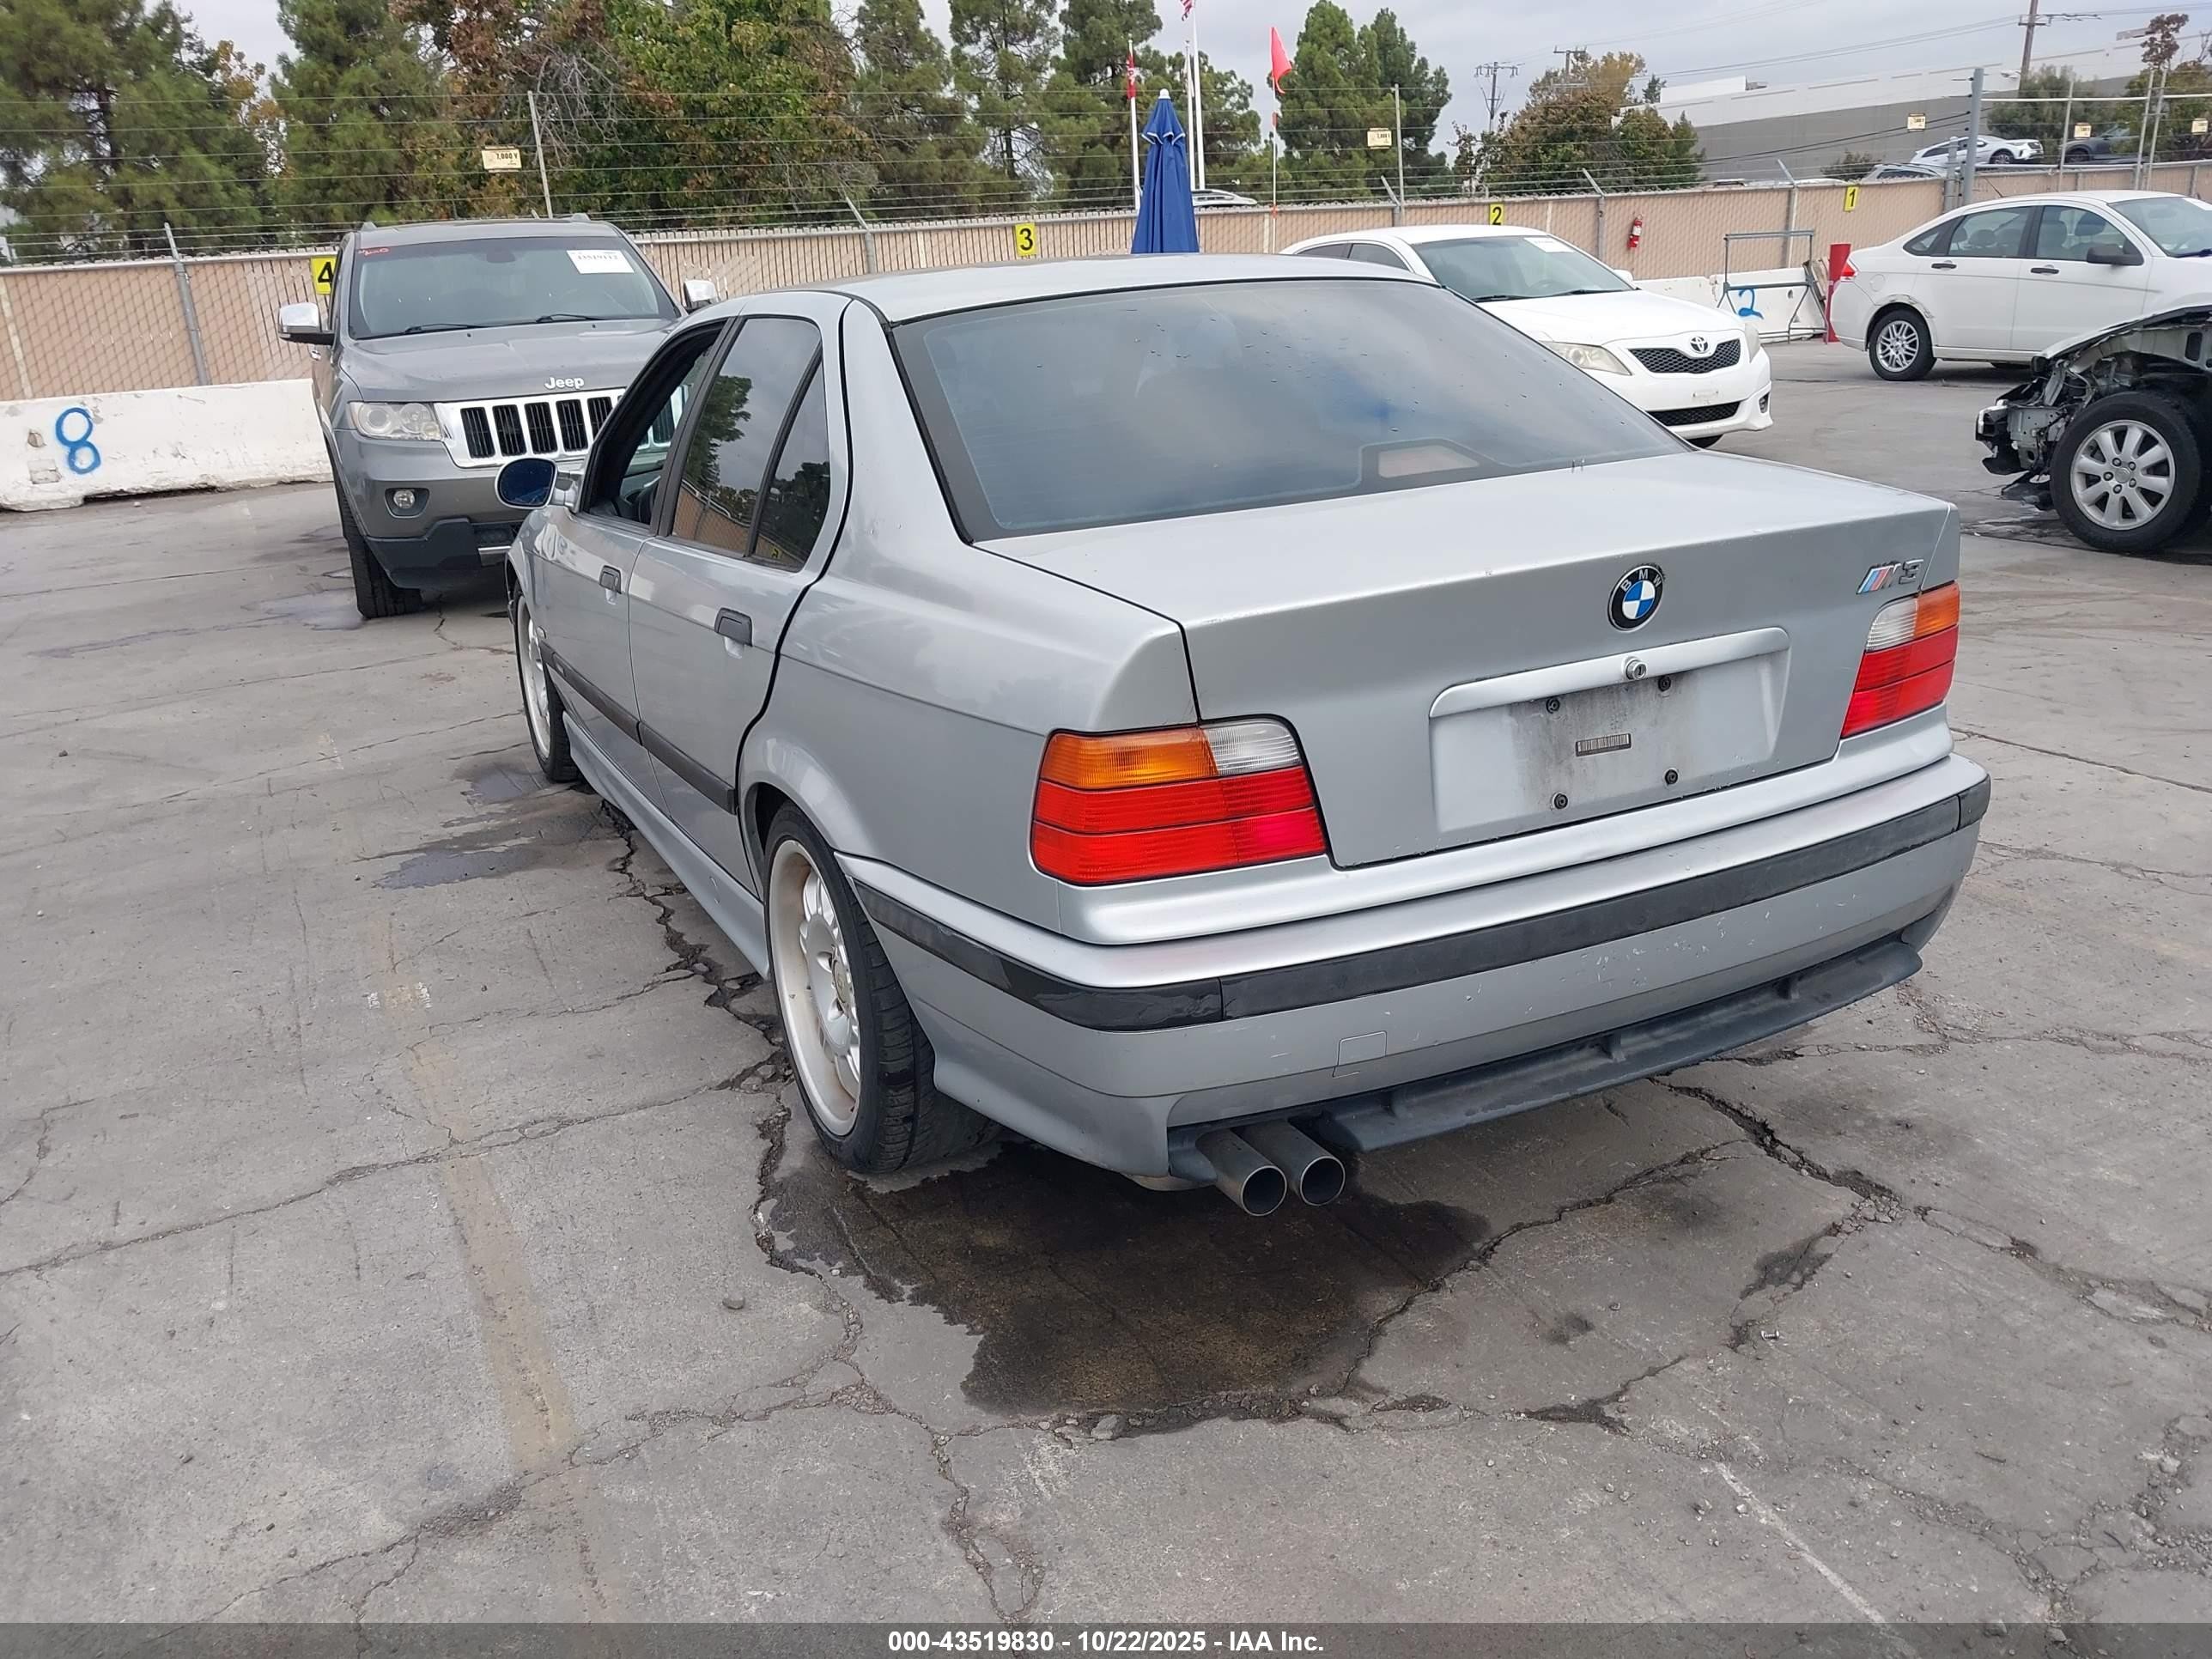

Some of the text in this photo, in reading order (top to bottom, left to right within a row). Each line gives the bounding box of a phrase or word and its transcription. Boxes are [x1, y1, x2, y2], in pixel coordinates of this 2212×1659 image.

[1849, 189, 1856, 208] 1
[1492, 206, 1502, 225] 2
[1019, 228, 1033, 251] 3
[318, 261, 335, 283] 4
[1738, 288, 1765, 319] 2
[544, 377, 585, 390] Jeep
[55, 407, 101, 475] 8
[1620, 568, 1662, 592] BMW
